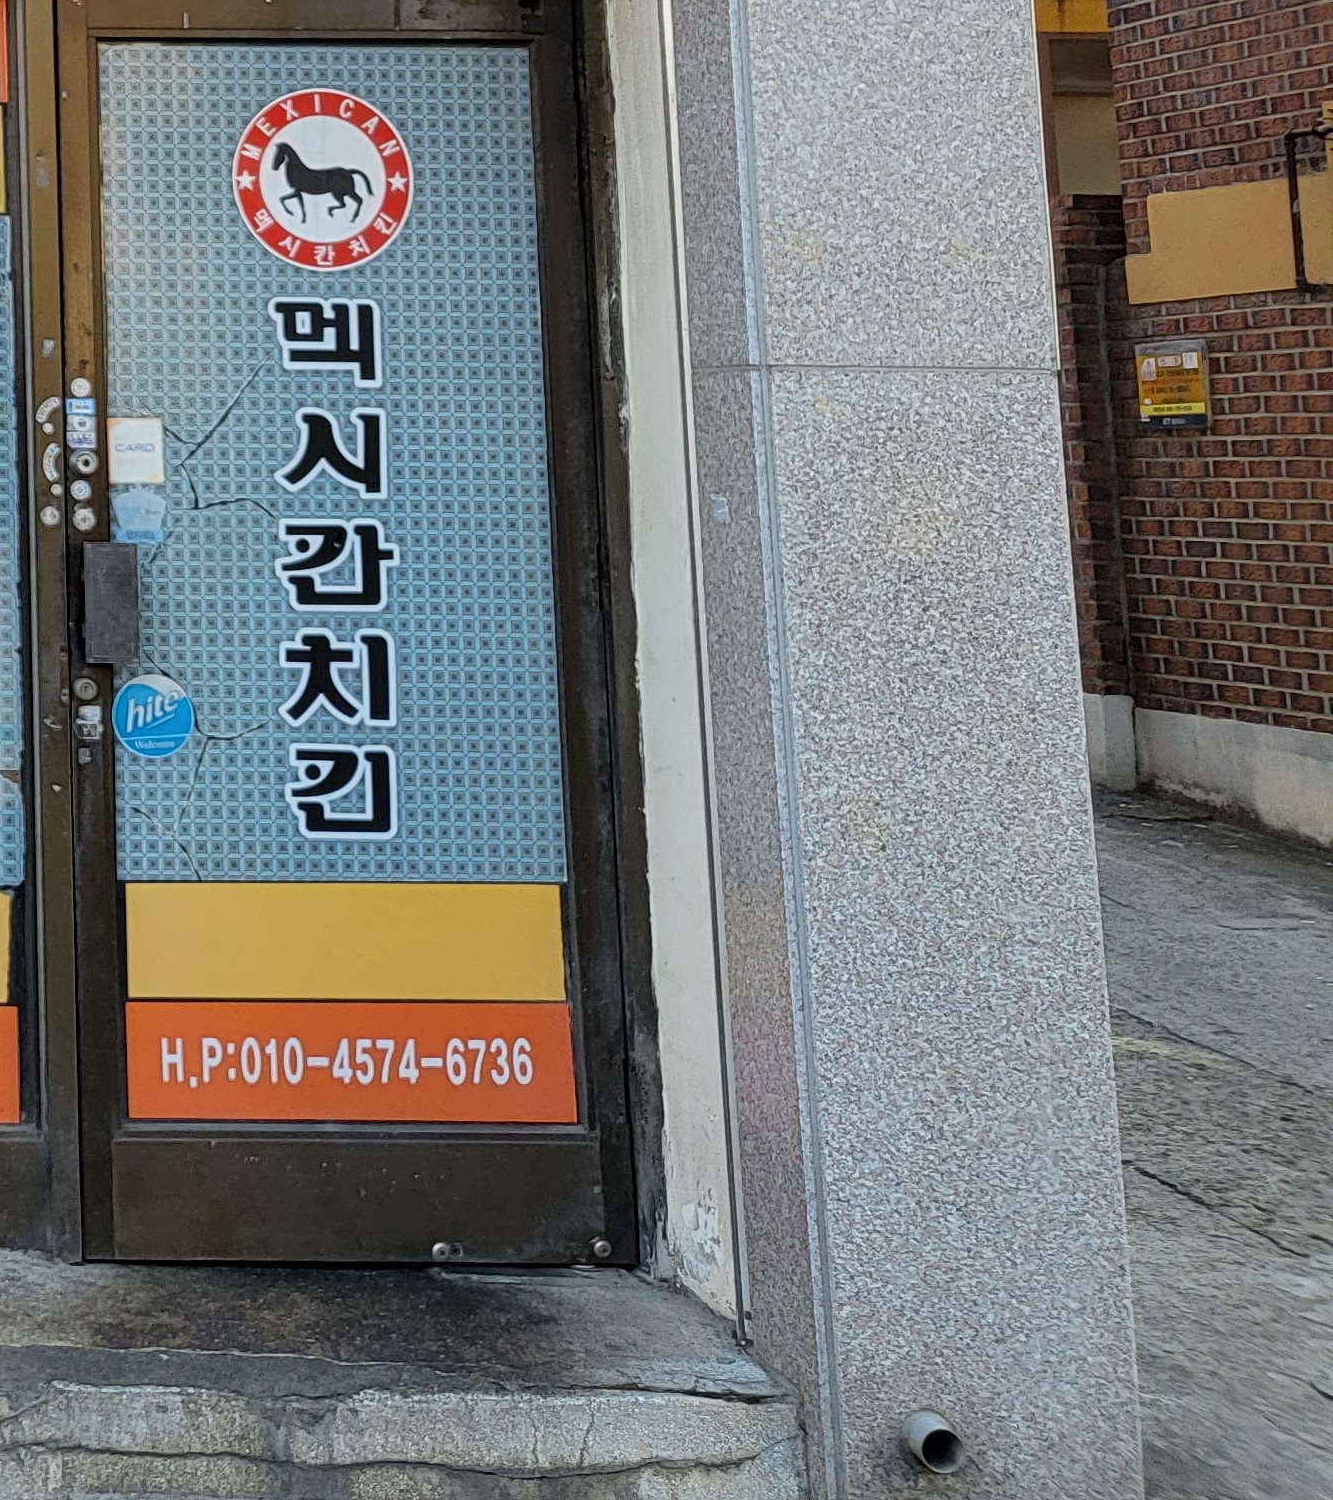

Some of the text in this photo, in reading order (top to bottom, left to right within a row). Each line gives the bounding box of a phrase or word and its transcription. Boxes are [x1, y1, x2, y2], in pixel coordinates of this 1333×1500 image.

[239, 93, 401, 161] MEXICAN
[252, 206, 399, 268] 멕시칸치킨
[114, 443, 156, 453] CARD
[268, 297, 400, 840] 멕시칸치킨
[125, 689, 179, 734] hite
